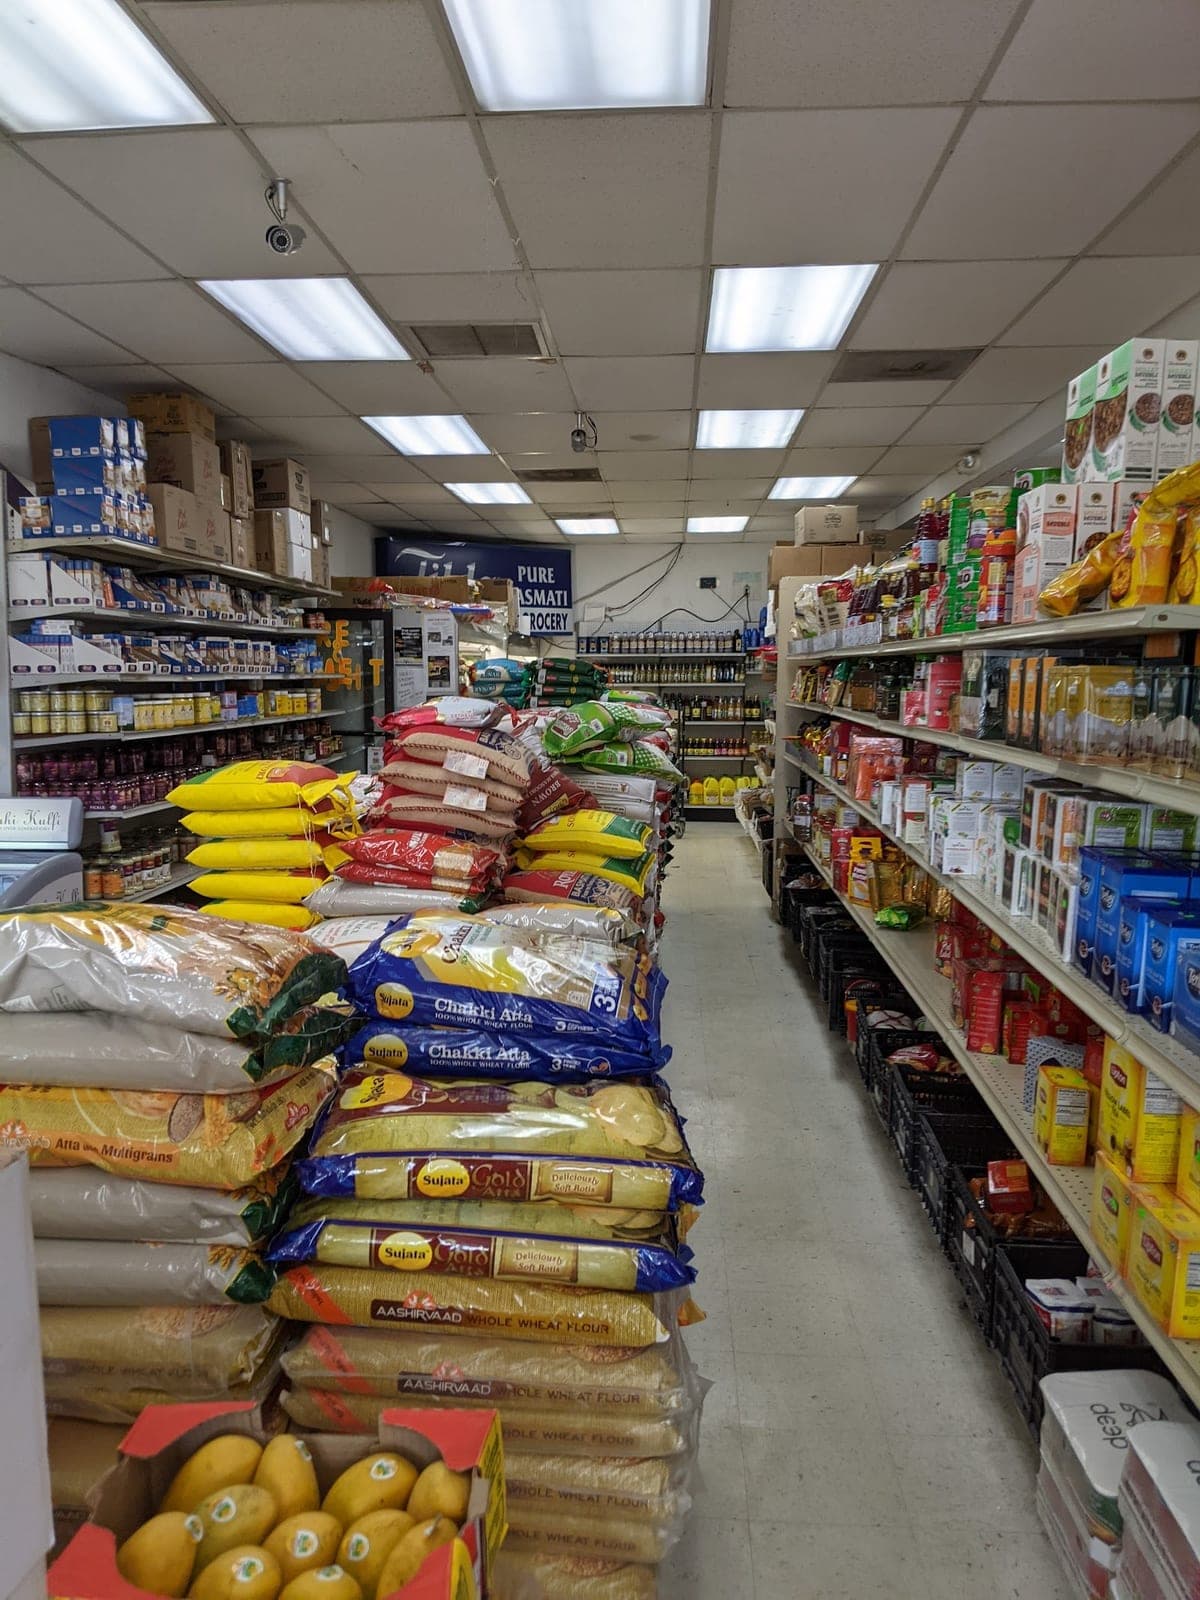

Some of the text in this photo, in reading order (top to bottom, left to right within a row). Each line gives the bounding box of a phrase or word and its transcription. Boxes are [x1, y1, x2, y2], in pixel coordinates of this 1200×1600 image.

[517, 565, 556, 584] PURE
[519, 588, 568, 607] ASMATI
[522, 612, 569, 630] ROCERY
[23, 809, 61, 831] Kulfi
[379, 992, 409, 1008] Sujata
[594, 994, 616, 1013] 3
[434, 998, 533, 1024] Chakki Atta
[456, 1016, 481, 1026] WHOLE
[484, 1019, 507, 1029] WHEAT
[510, 1021, 533, 1030] FLOUR
[368, 1046, 403, 1060] Sujata
[428, 1044, 532, 1061] Chakki Atta
[452, 1060, 477, 1068] WHOLE
[479, 1061, 504, 1069] WHEAT
[551, 1058, 562, 1071] 3
[55, 1138, 81, 1151] Atta
[101, 1143, 173, 1164] Multigrains
[423, 1164, 600, 1188] Sujata Gold Deliciously
[554, 1183, 572, 1193] Soft
[574, 1184, 595, 1194] Rotis
[384, 1239, 563, 1265] Sujata Gold Deliciously
[518, 1261, 537, 1272] Soft
[539, 1263, 560, 1274] Rotis
[376, 1305, 609, 1335] AASHIRVAAD WHOLE WHEAT FLOUR
[403, 1378, 492, 1395] AASHIRVAAD
[547, 1389, 593, 1401] WHEAT
[597, 1393, 641, 1405] FLOUR
[502, 1428, 634, 1446] HOLE WHEAT FLOUR
[558, 1490, 600, 1504] WHEAT
[607, 1497, 648, 1509] FLOUR
[546, 1533, 590, 1545] WHEAT
[594, 1538, 636, 1551] FLOUR
